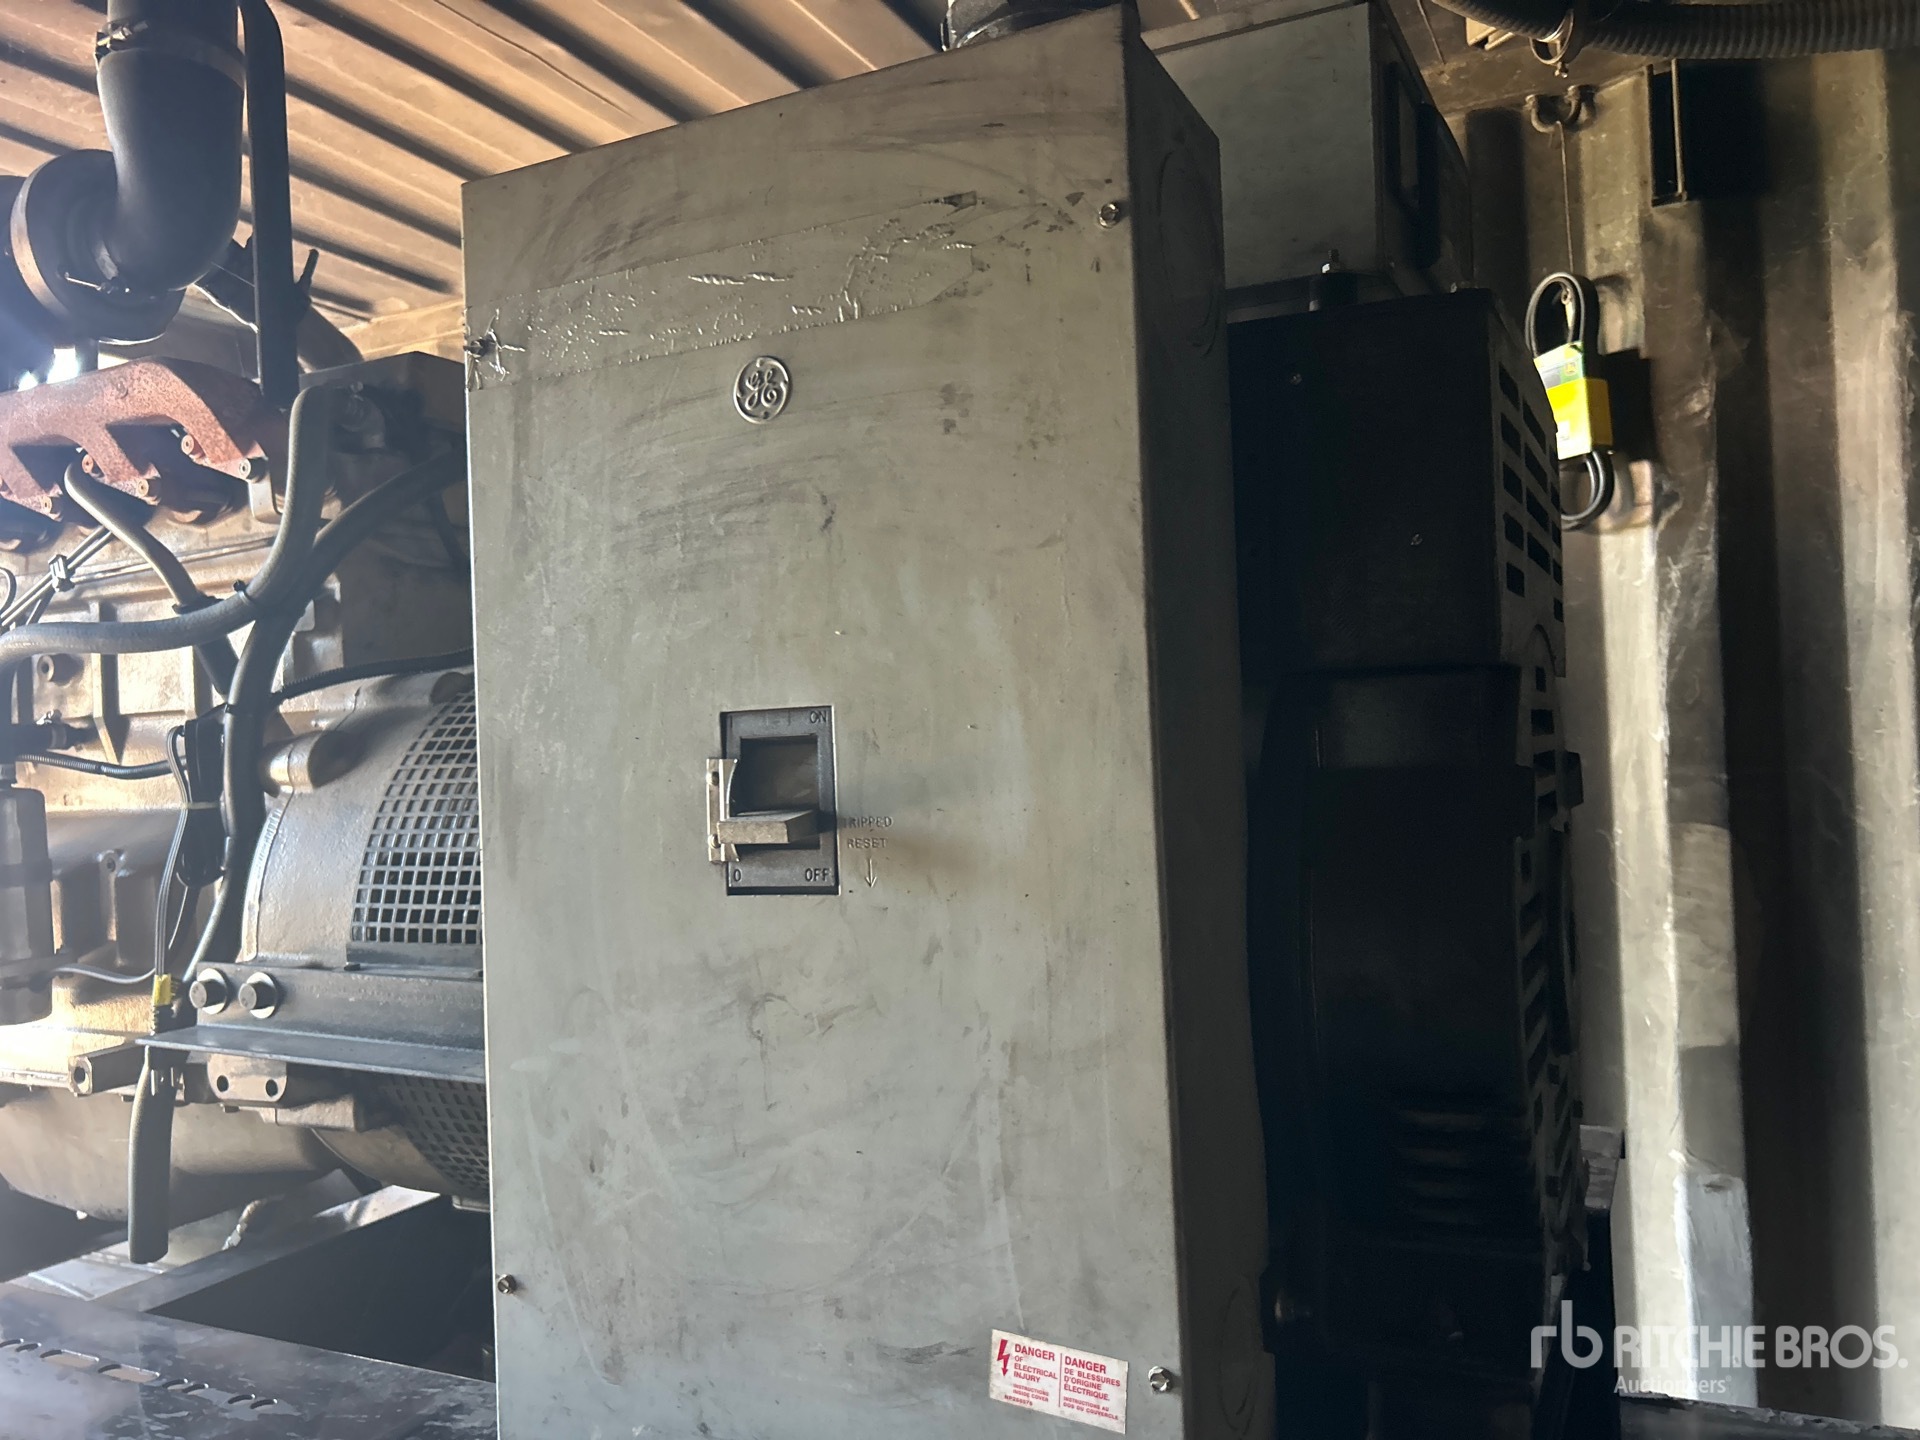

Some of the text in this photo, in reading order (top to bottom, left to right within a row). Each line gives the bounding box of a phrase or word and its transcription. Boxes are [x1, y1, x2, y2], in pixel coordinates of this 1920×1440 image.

[809, 710, 827, 724] ON
[848, 837, 888, 849] RESET
[805, 867, 829, 882] OFF
[1014, 1344, 1055, 1361] DANGER
[1014, 1355, 1024, 1363] OF
[1014, 1363, 1058, 1379] ELECTRICAL
[1064, 1356, 1106, 1374] DANGER
[1013, 1371, 1041, 1383] INJURY
[1064, 1367, 1121, 1387] DE BLESSURES
[1064, 1375, 1102, 1391] D'ORIGINE
[1012, 1383, 1050, 1397] INSTRUCTIONS
[1012, 1389, 1049, 1403] INSIDE COVER
[1063, 1396, 1100, 1410] INSTRUCTIONS
